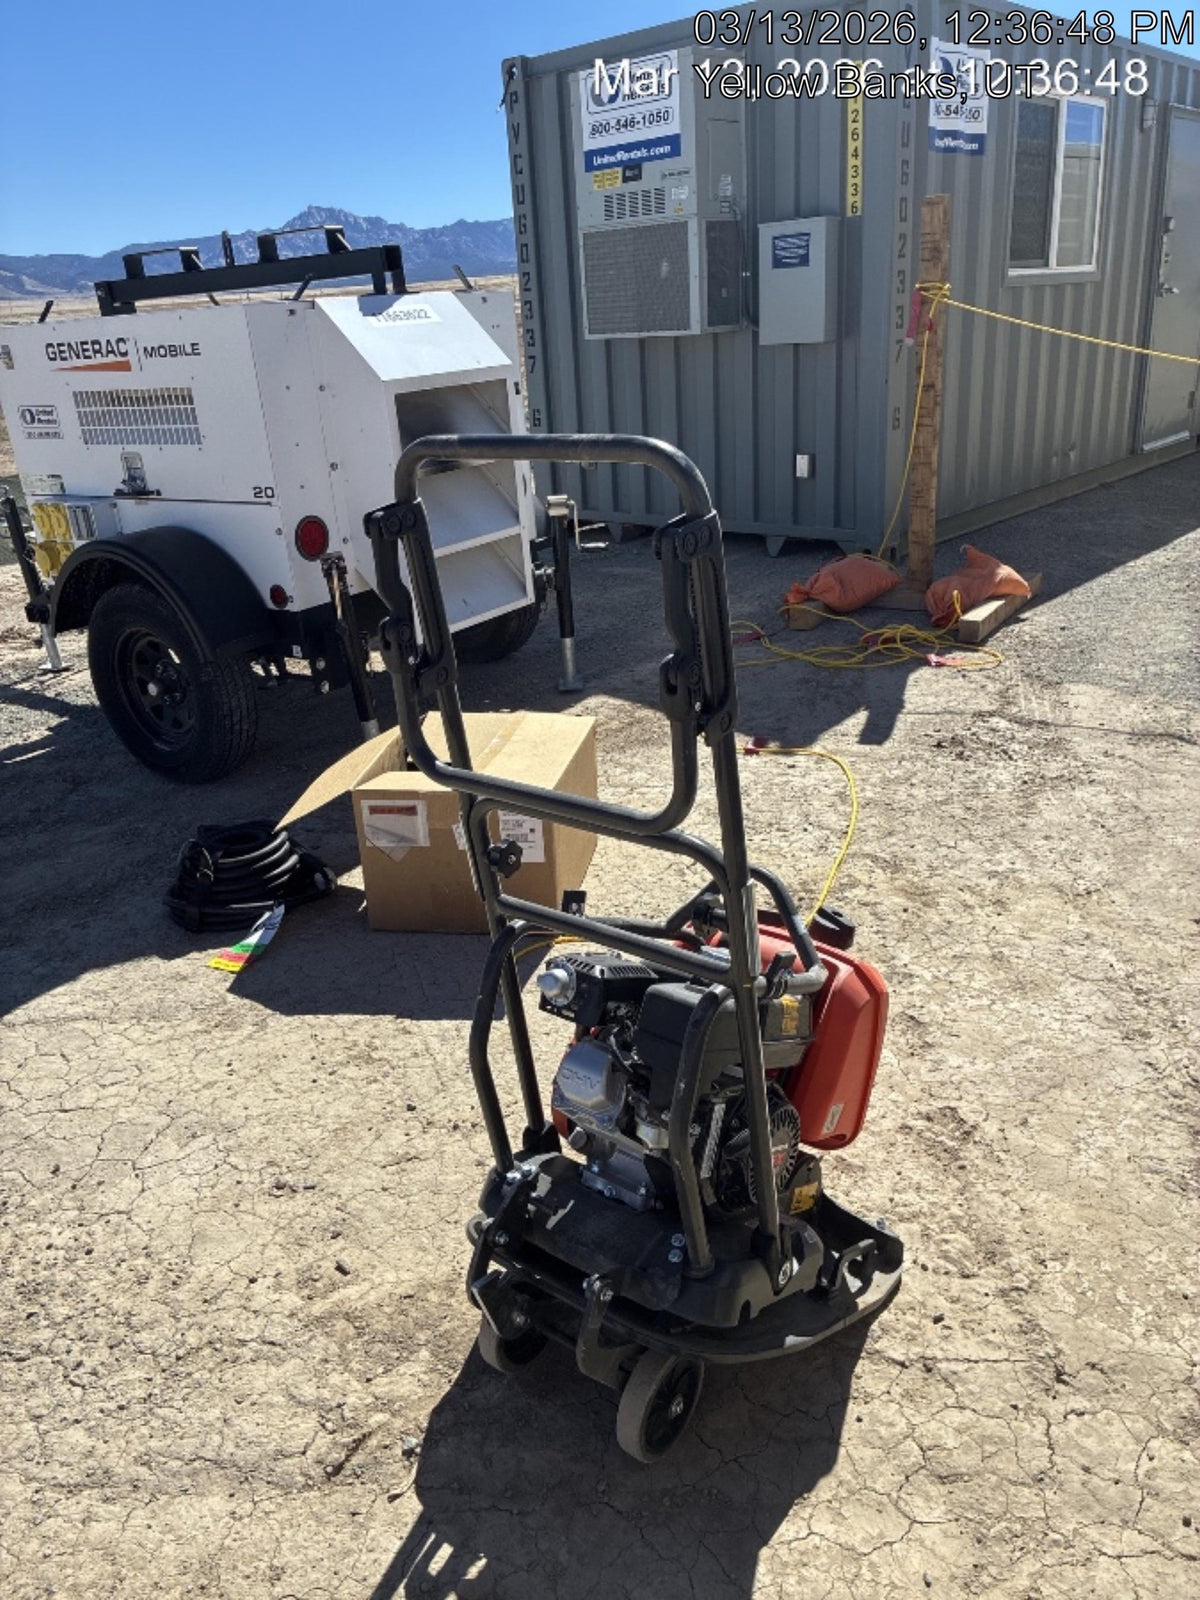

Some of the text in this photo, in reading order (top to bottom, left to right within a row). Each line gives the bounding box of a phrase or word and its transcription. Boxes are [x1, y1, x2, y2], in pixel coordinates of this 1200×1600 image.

[590, 109, 670, 136] 800-546-1050
[45, 337, 201, 361] GENERAC MOBILE
[252, 486, 275, 498] 20
